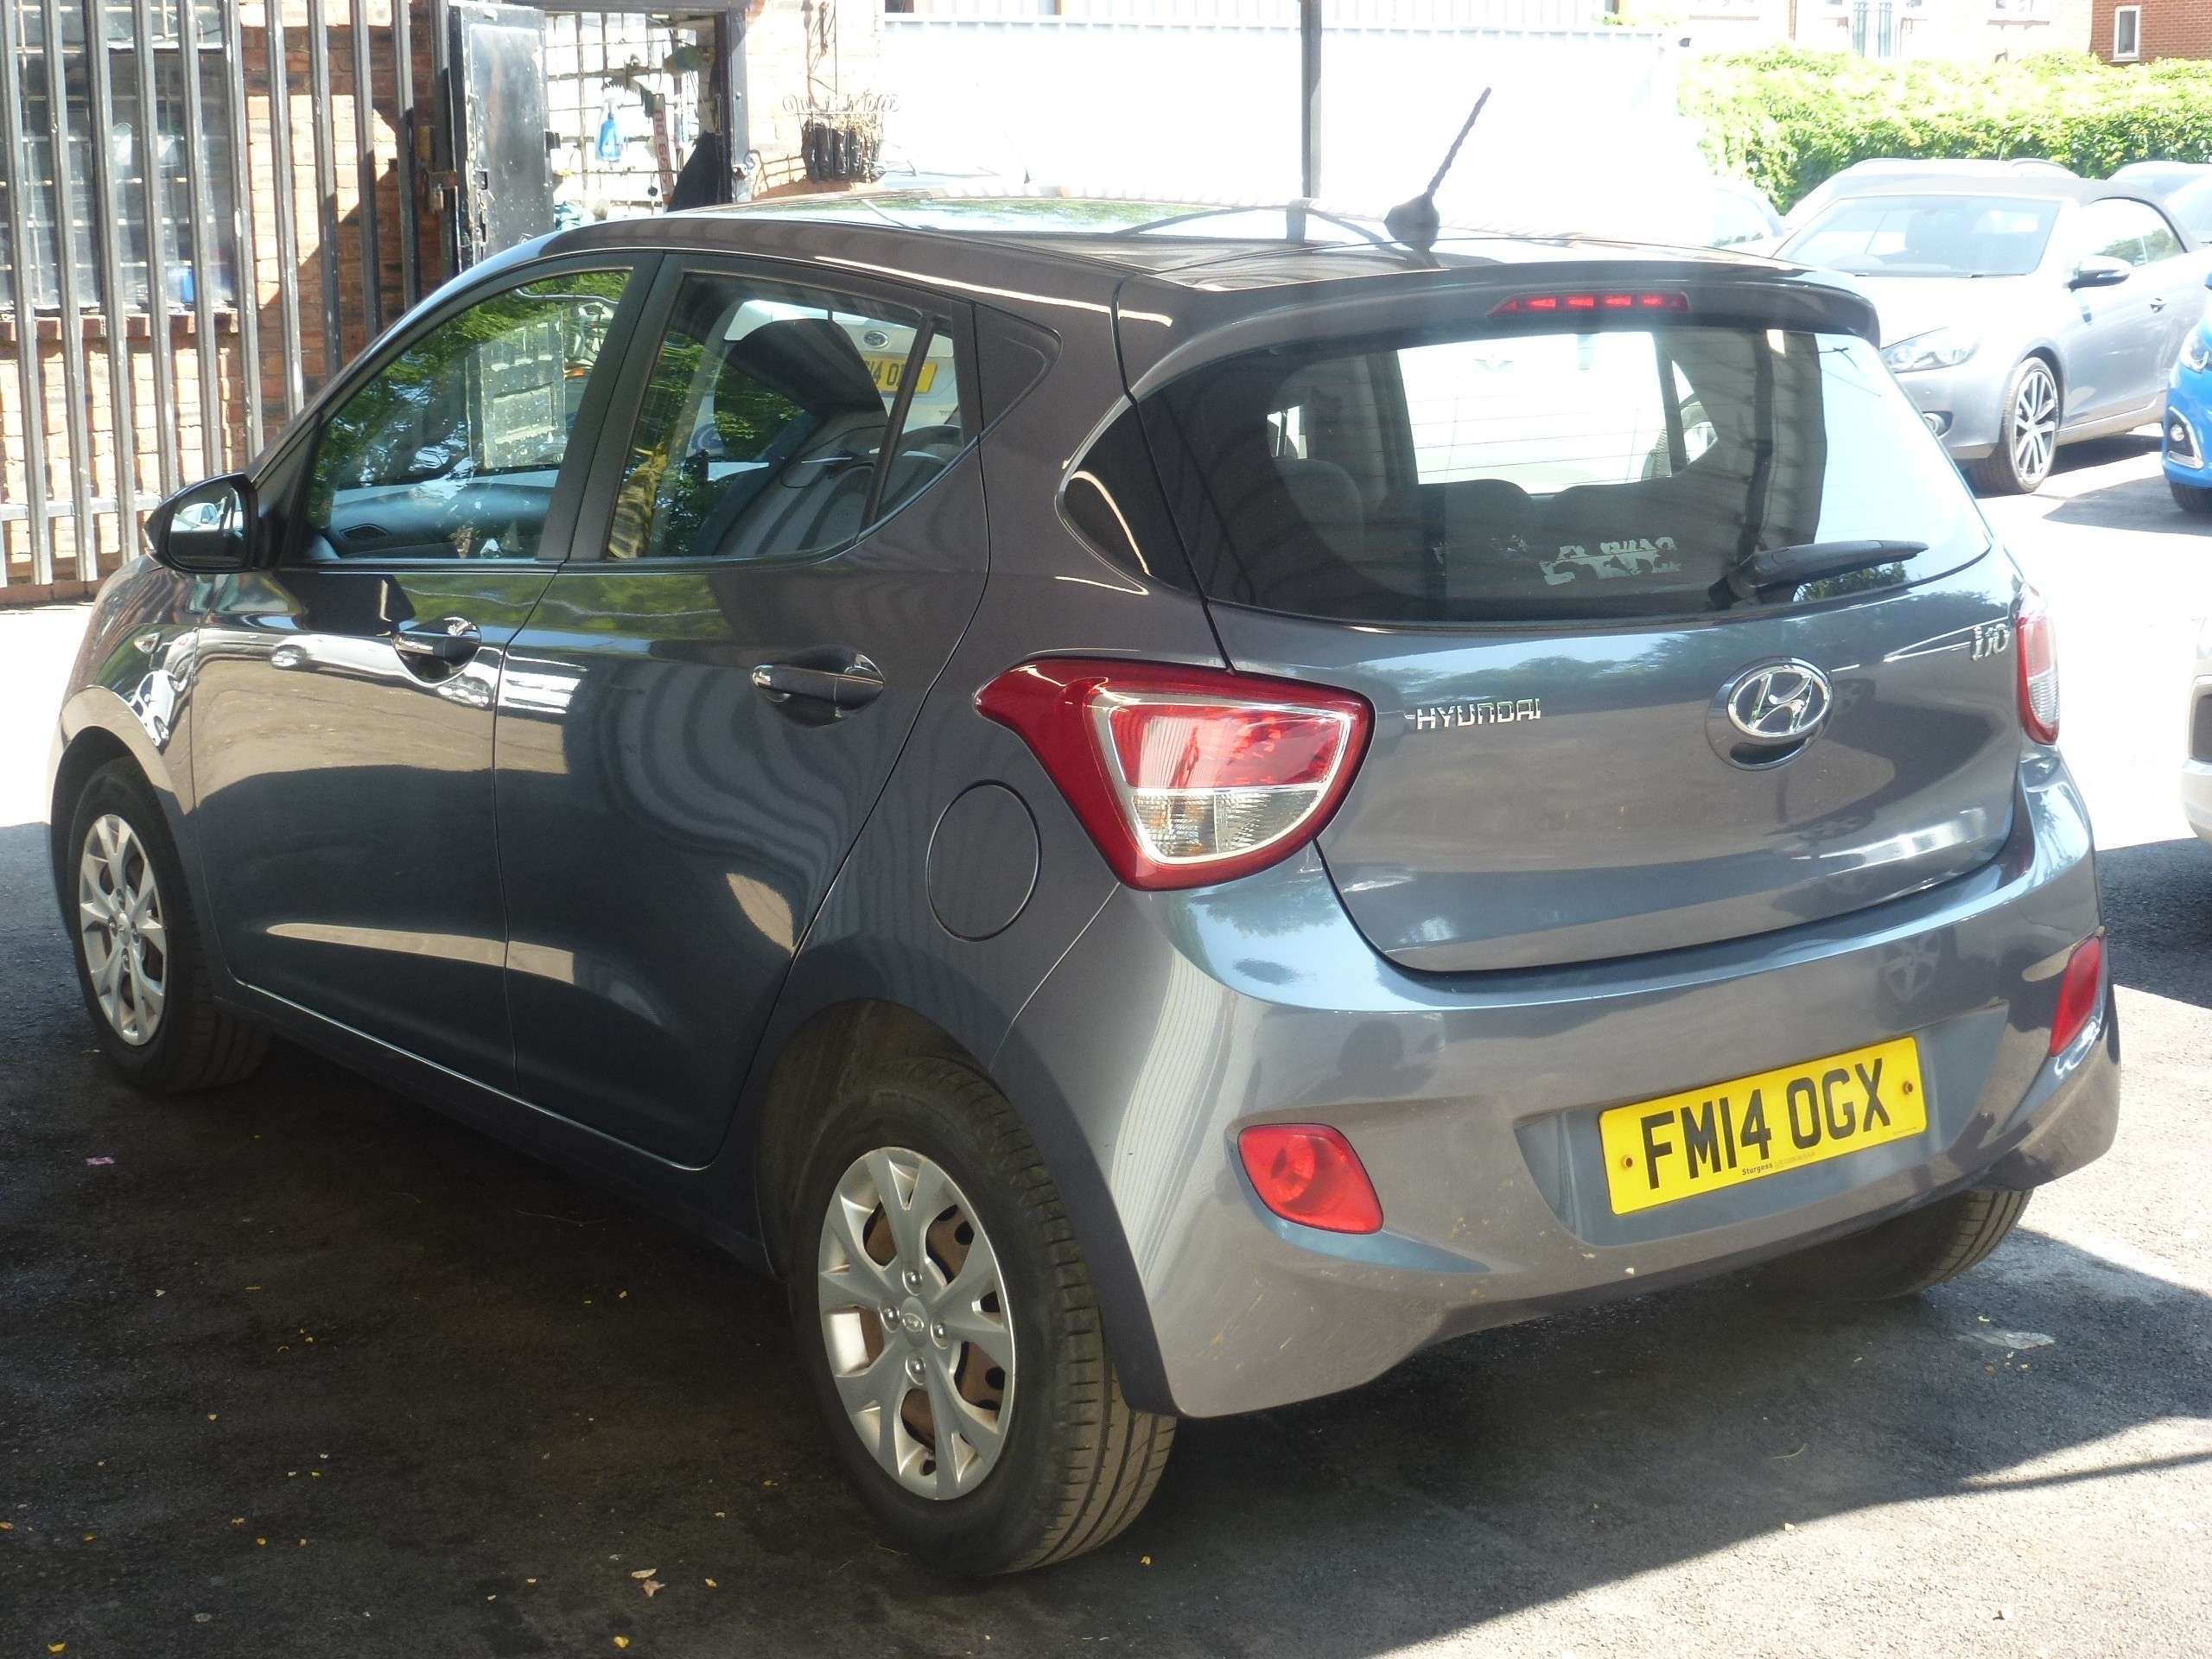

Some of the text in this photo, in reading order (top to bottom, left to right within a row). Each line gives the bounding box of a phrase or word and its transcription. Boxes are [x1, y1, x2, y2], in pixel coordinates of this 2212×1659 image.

[1416, 698, 1541, 730] HYUNDAI
[1640, 1058, 1891, 1190] FM14 OGX
[1742, 1162, 1774, 1176] Sturgess
